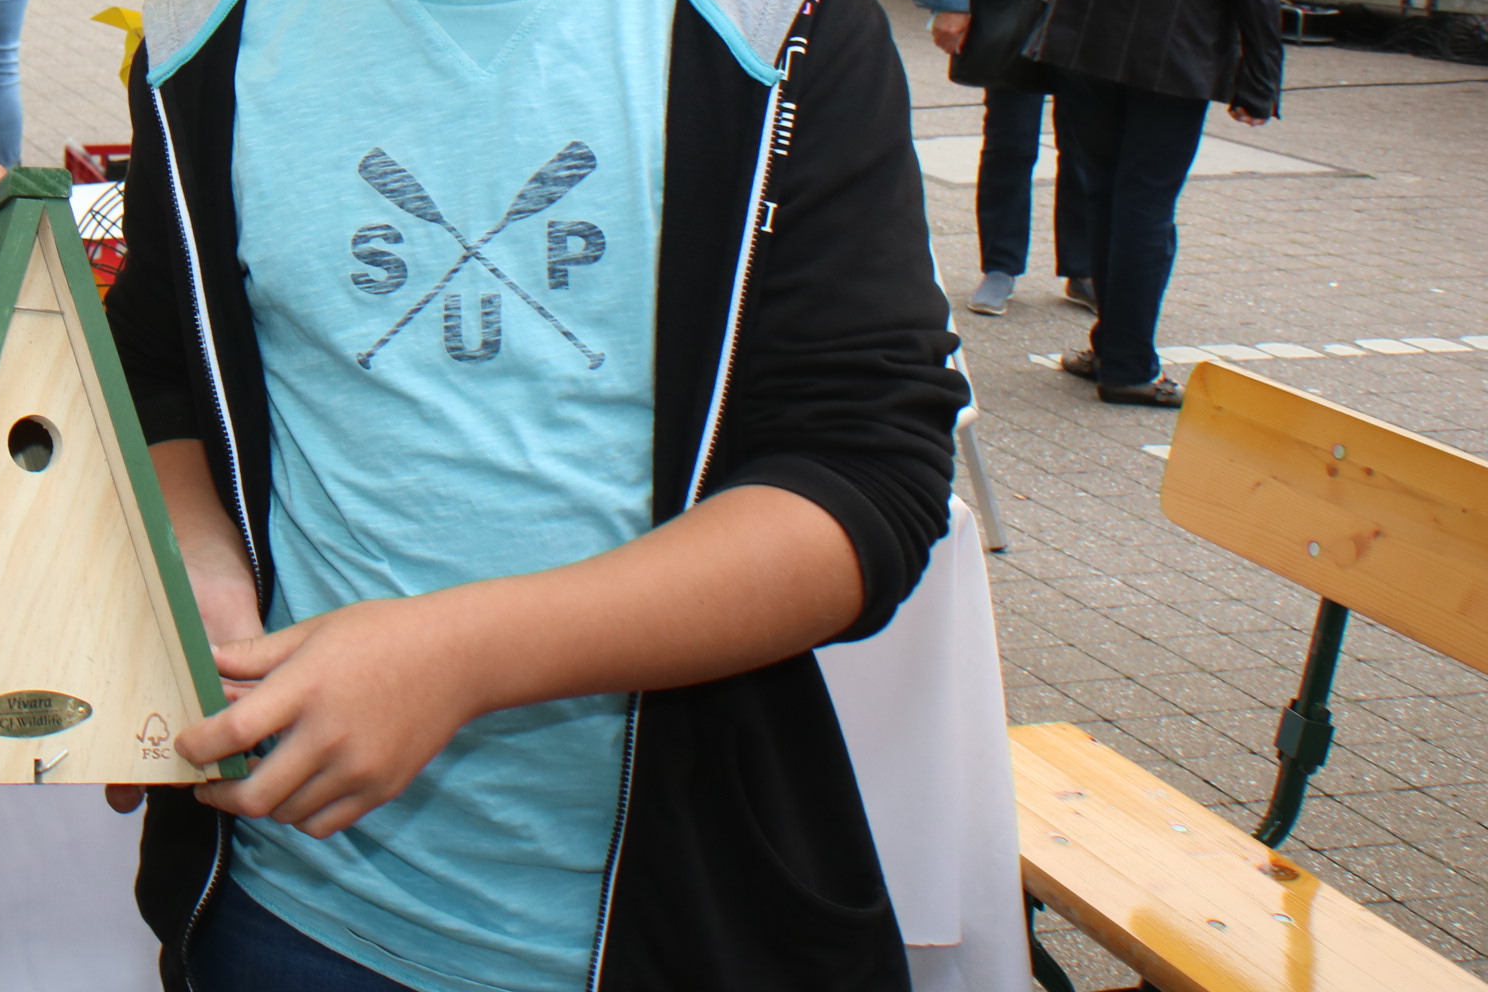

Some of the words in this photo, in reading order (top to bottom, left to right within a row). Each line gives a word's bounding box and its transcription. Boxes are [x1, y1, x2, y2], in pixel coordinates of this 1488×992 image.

[7, 697, 53, 710] Vivara
[15, 714, 62, 727] Wildlife
[142, 748, 173, 760] FSC
